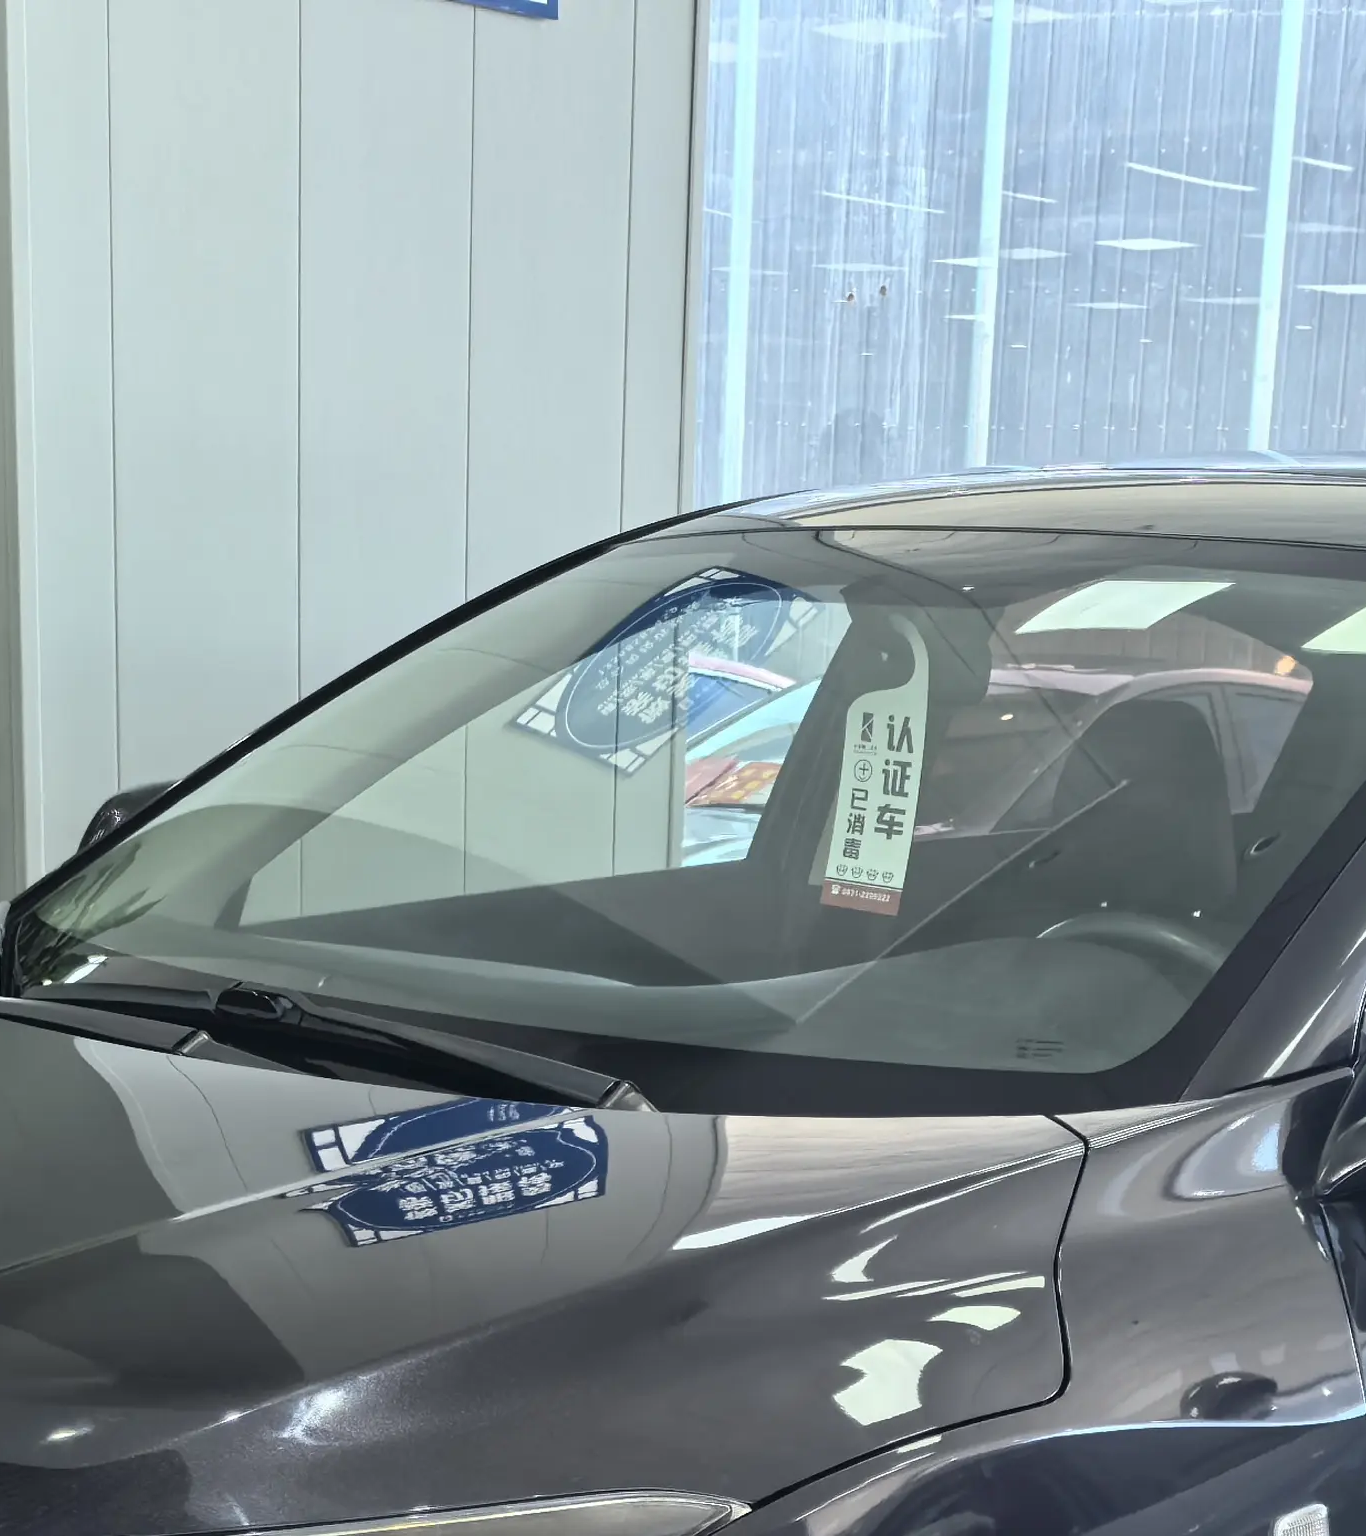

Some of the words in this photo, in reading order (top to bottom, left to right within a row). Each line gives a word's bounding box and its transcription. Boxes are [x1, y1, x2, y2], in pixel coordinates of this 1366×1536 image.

[842, 787, 869, 860] 已消毒
[874, 714, 914, 840] 认证车
